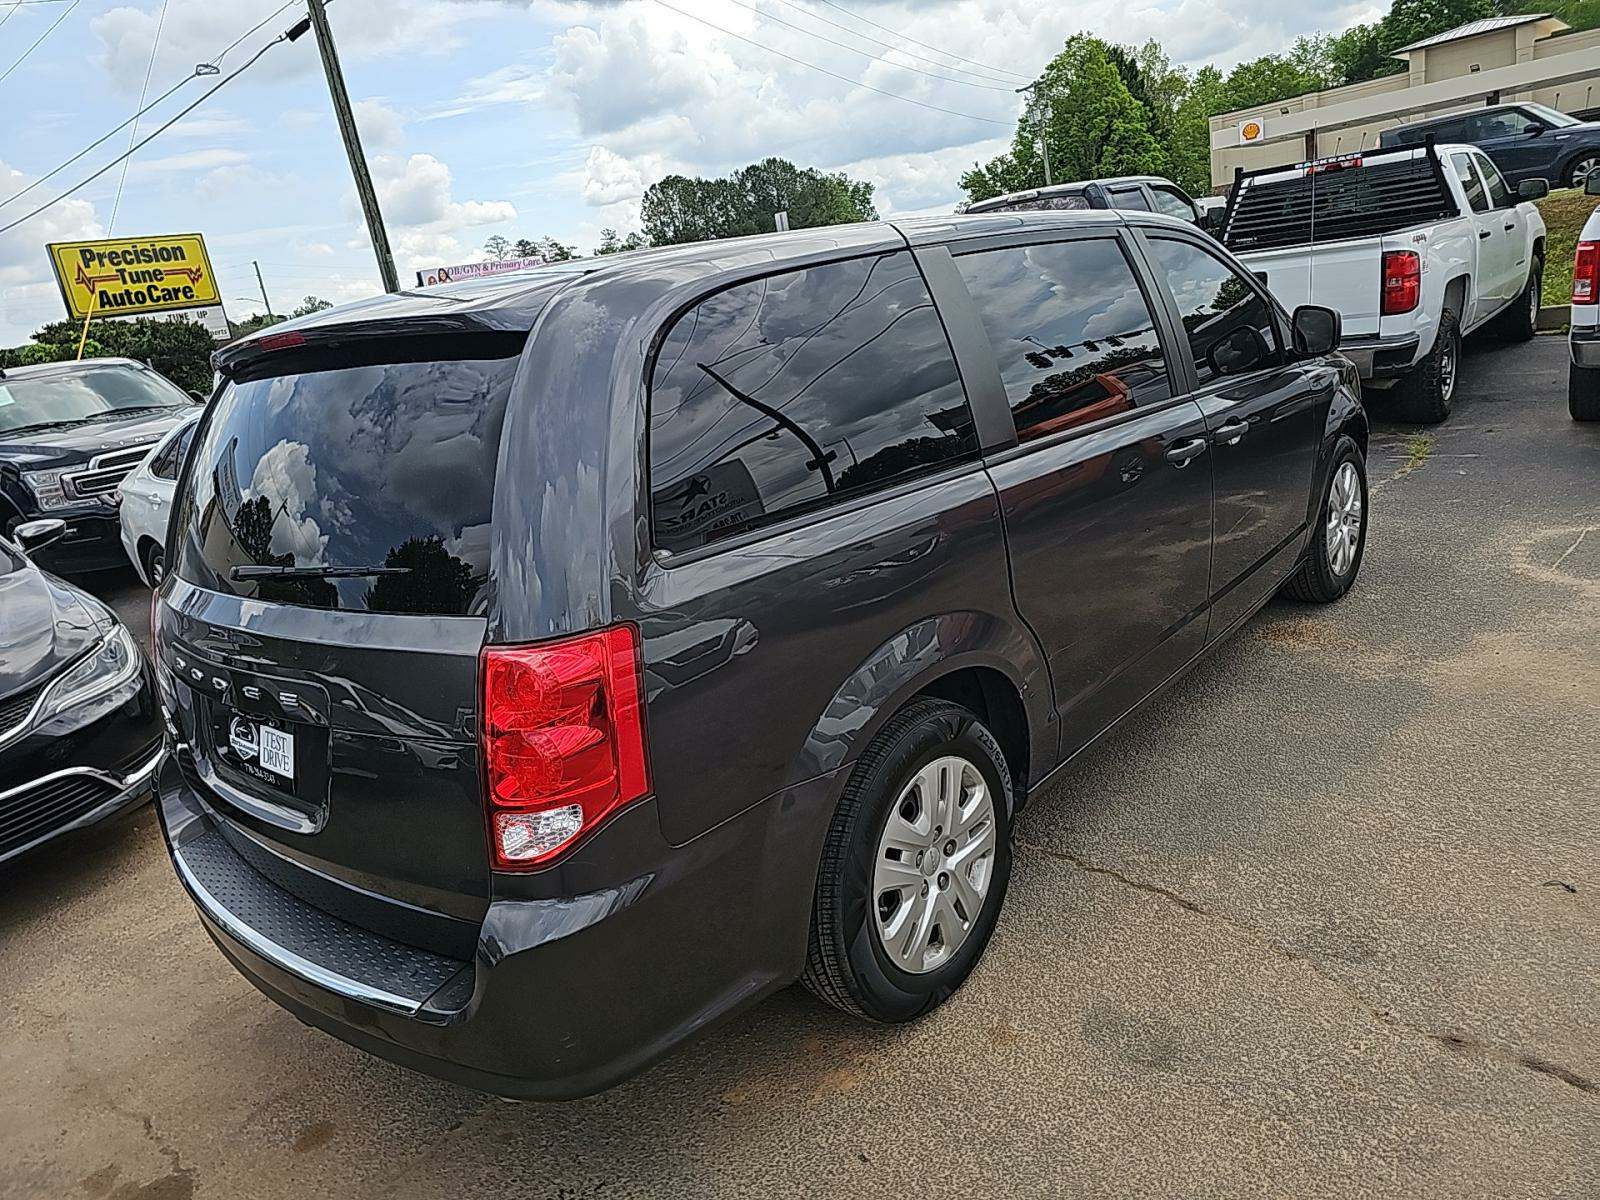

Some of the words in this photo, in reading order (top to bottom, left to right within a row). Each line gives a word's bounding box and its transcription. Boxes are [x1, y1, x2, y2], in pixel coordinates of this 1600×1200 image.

[79, 244, 187, 268] Precision
[490, 260, 522, 271] Primary
[522, 258, 541, 267] Care
[116, 267, 165, 285] Tune
[264, 730, 288, 754] TEST
[263, 748, 290, 772] DRIVE
